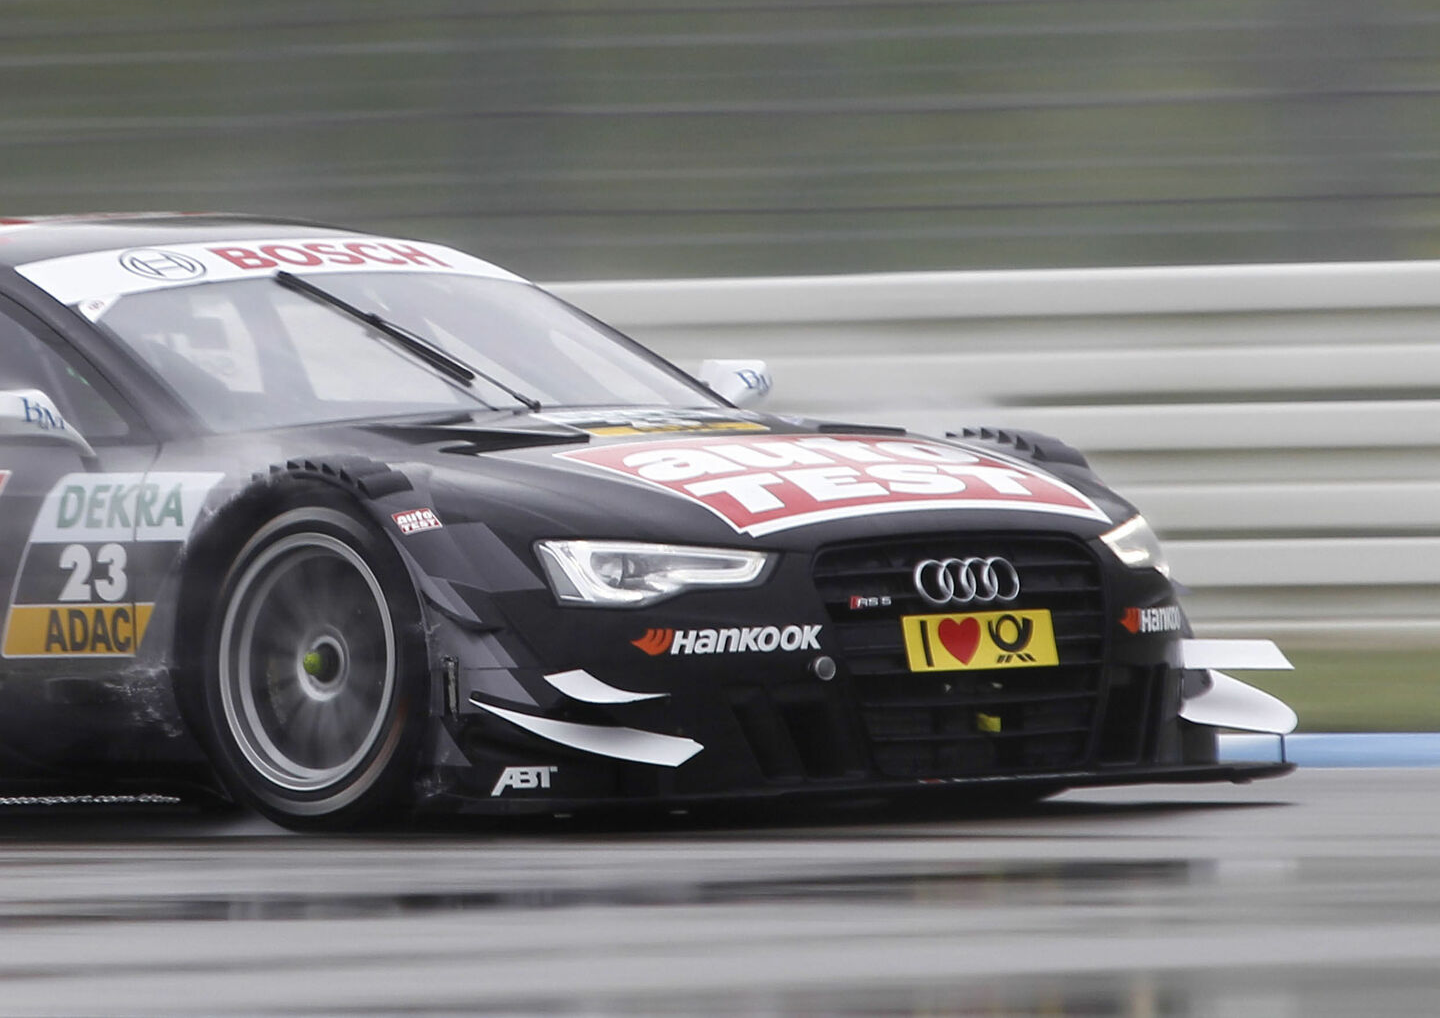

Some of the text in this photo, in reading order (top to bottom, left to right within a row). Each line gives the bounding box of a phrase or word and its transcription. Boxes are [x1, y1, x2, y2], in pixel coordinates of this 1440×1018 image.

[208, 243, 454, 270] BOSCH
[623, 436, 982, 481] auto
[56, 483, 184, 528] DEKRA
[684, 464, 1034, 514] TEST
[57, 543, 128, 602] 23
[45, 607, 132, 652] ADAC
[491, 766, 558, 796] ABT
